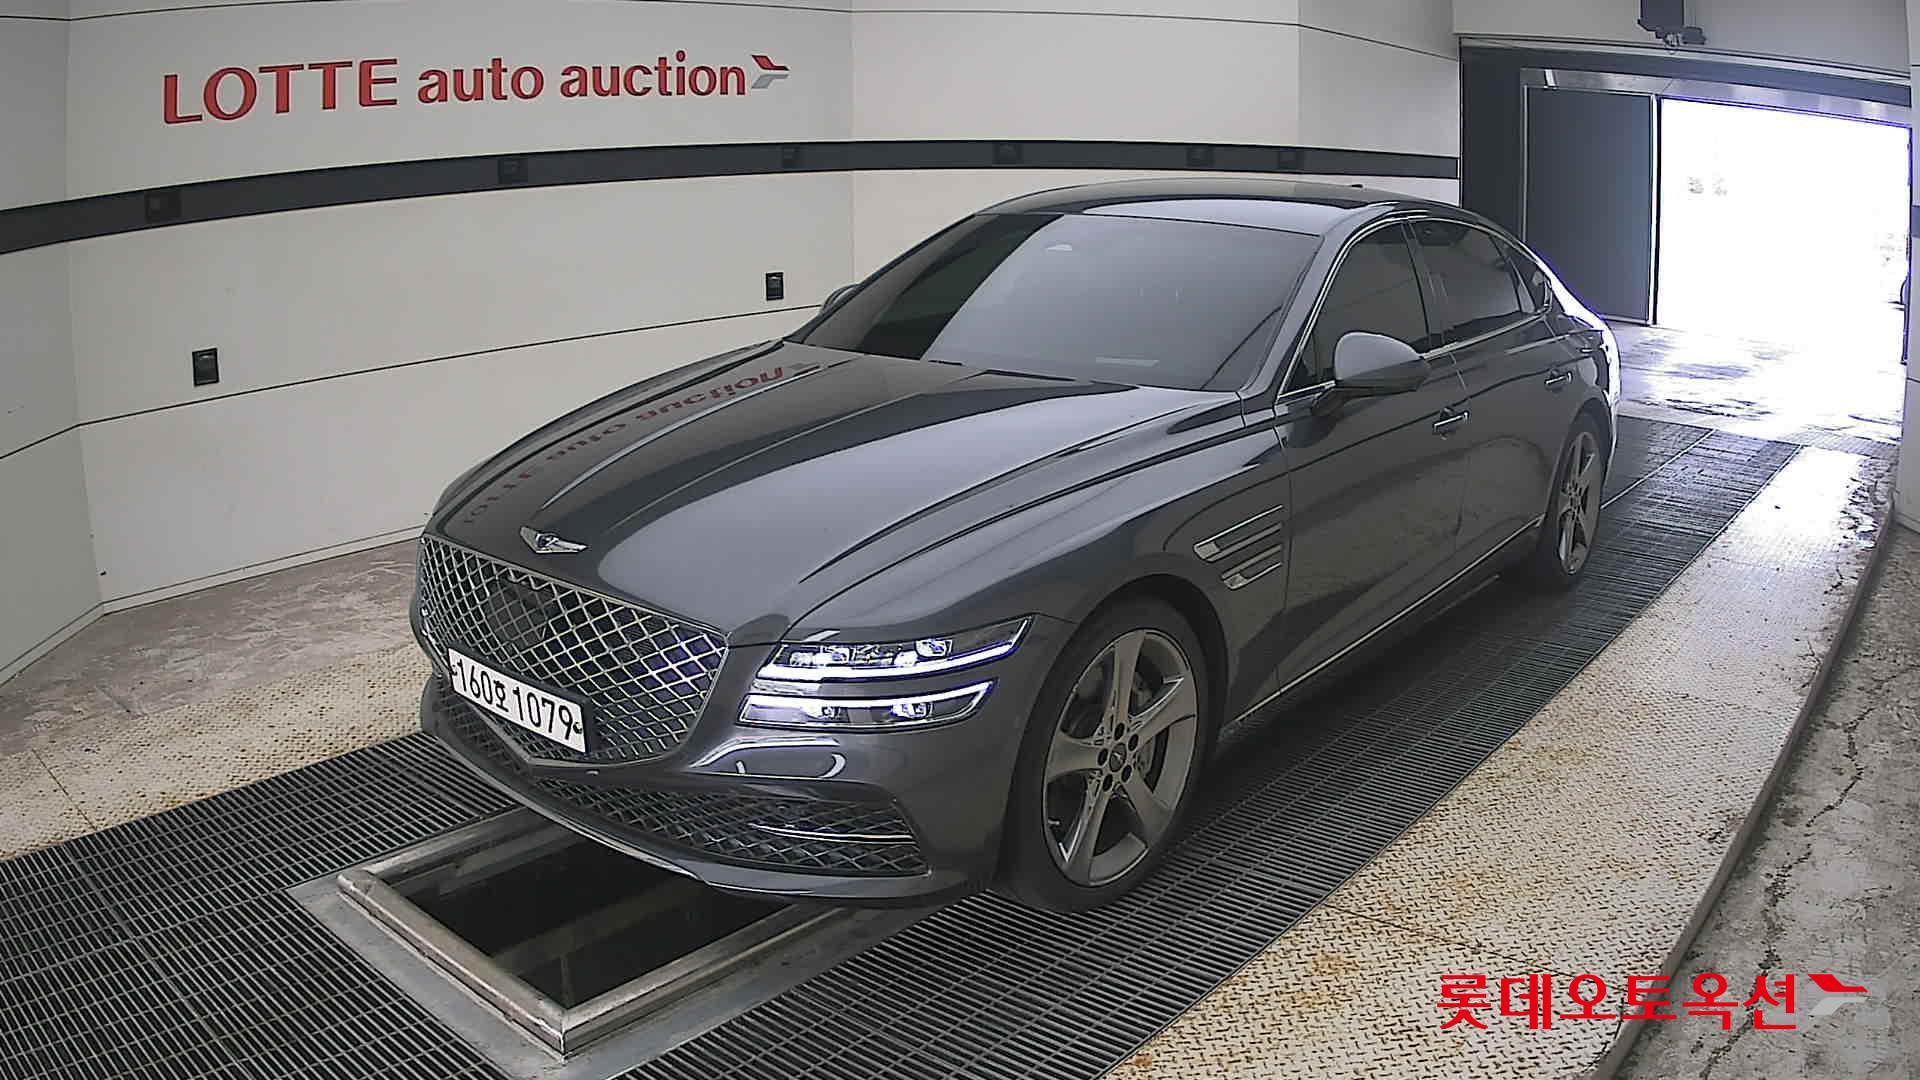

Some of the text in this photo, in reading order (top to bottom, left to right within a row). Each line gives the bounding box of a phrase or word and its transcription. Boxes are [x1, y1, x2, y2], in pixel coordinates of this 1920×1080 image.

[163, 49, 747, 125] LOTTE auto auction
[457, 658, 574, 741] 160호 1079
